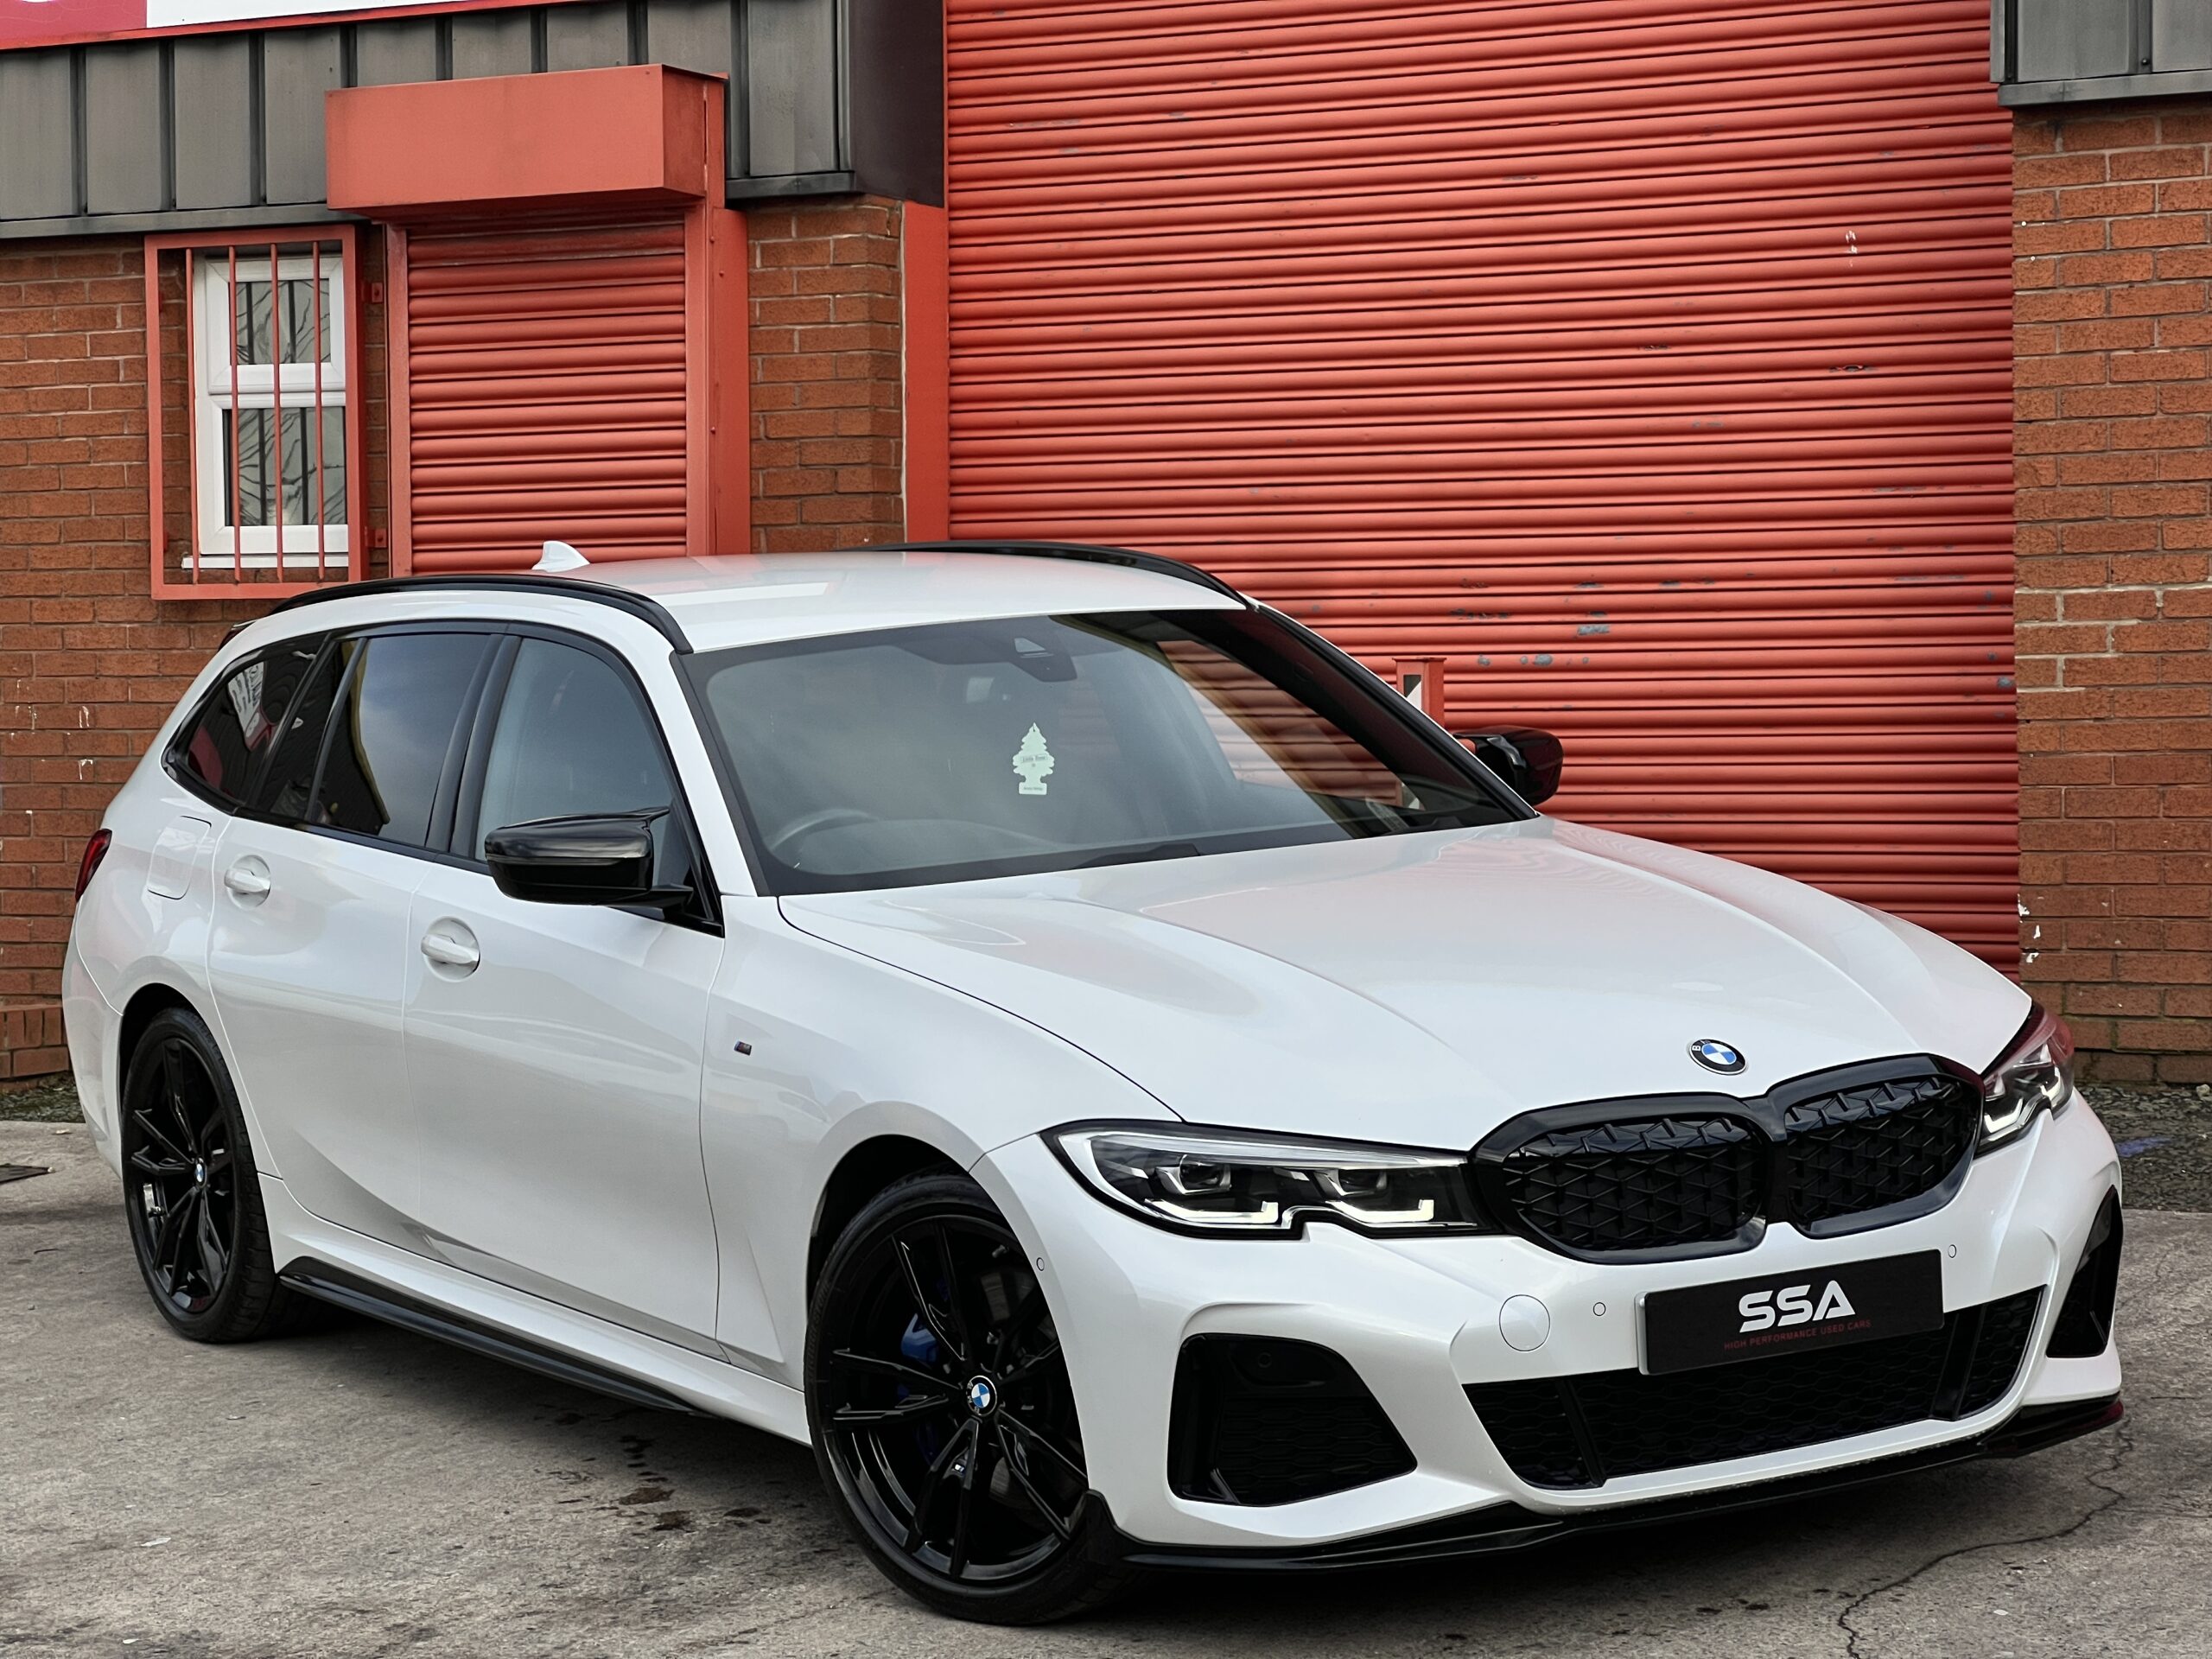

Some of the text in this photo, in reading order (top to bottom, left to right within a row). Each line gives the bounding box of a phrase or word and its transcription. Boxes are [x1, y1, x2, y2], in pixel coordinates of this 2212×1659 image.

[1738, 1280, 1856, 1333] SSA
[1724, 1319, 1872, 1350] HIGH PERFORMANCE USED CARS
